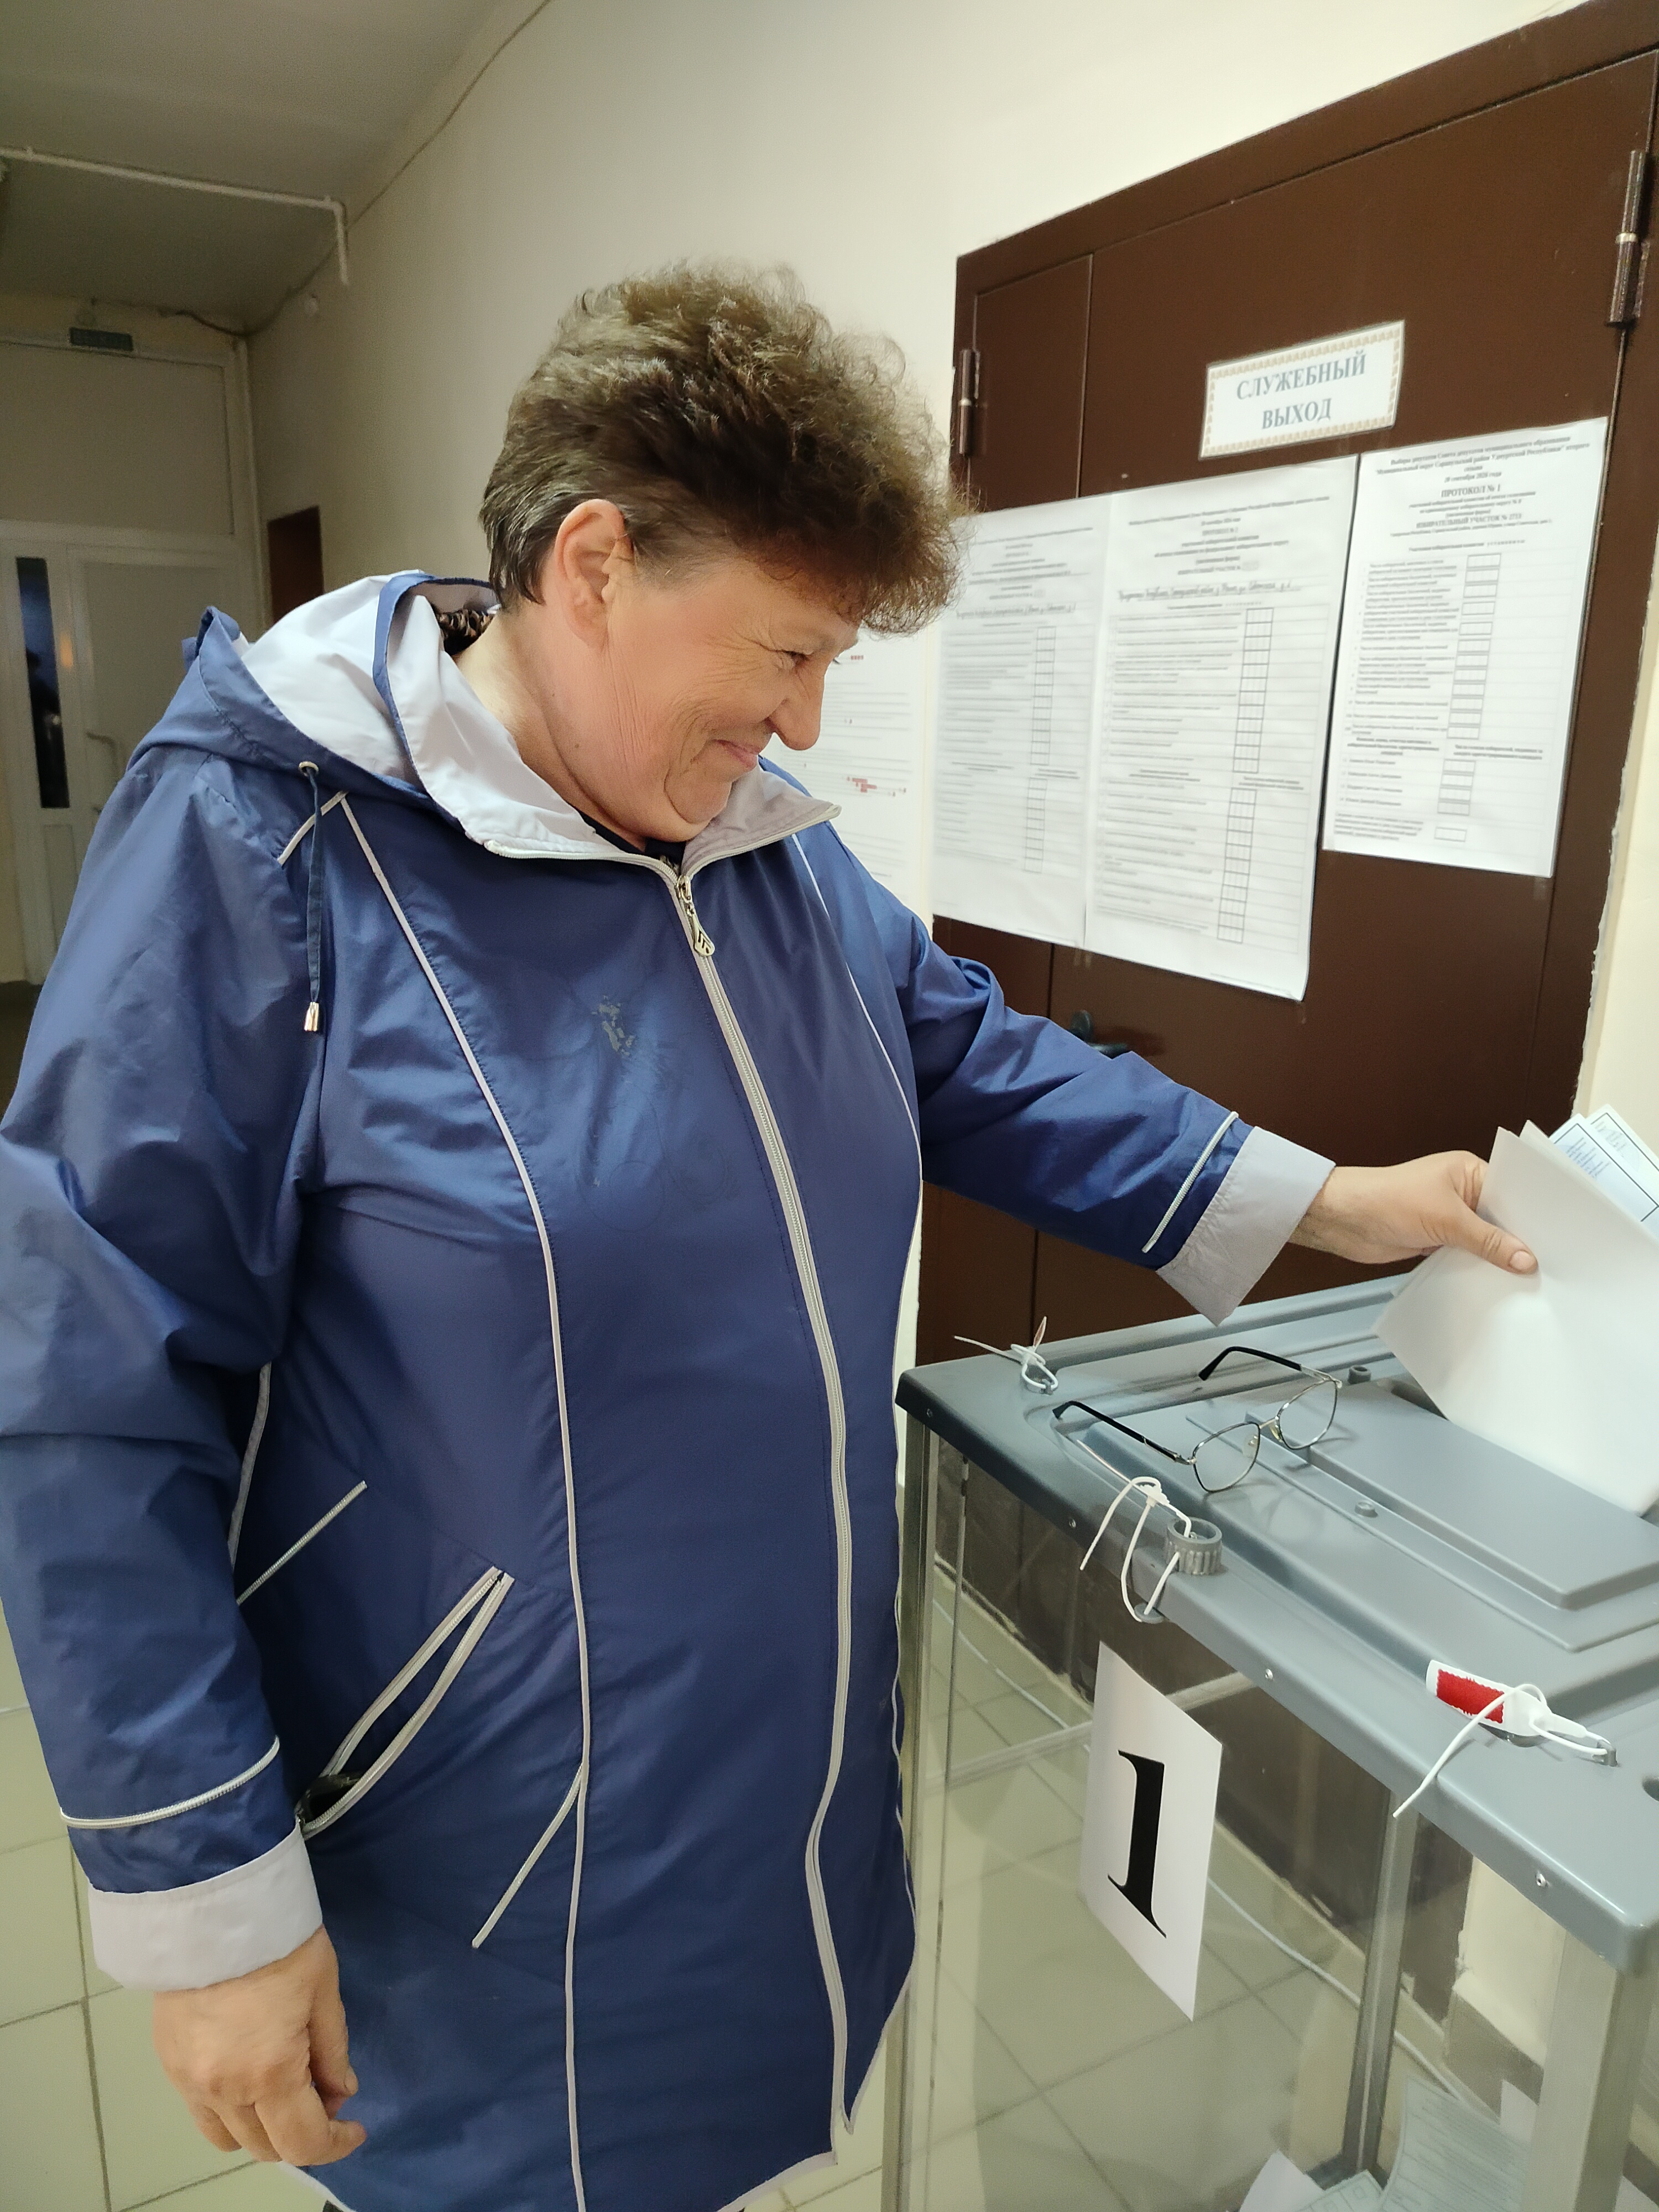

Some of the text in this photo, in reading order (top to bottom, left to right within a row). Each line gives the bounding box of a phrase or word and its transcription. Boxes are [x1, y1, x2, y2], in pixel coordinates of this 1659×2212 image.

[1237, 349, 1366, 400] СЛУЖЕБНЫЙ
[1261, 398, 1333, 430] ВЫХОД
[1441, 483, 1501, 498] ПРОТОКОЛ № 1
[1108, 1749, 1167, 1939] 1
